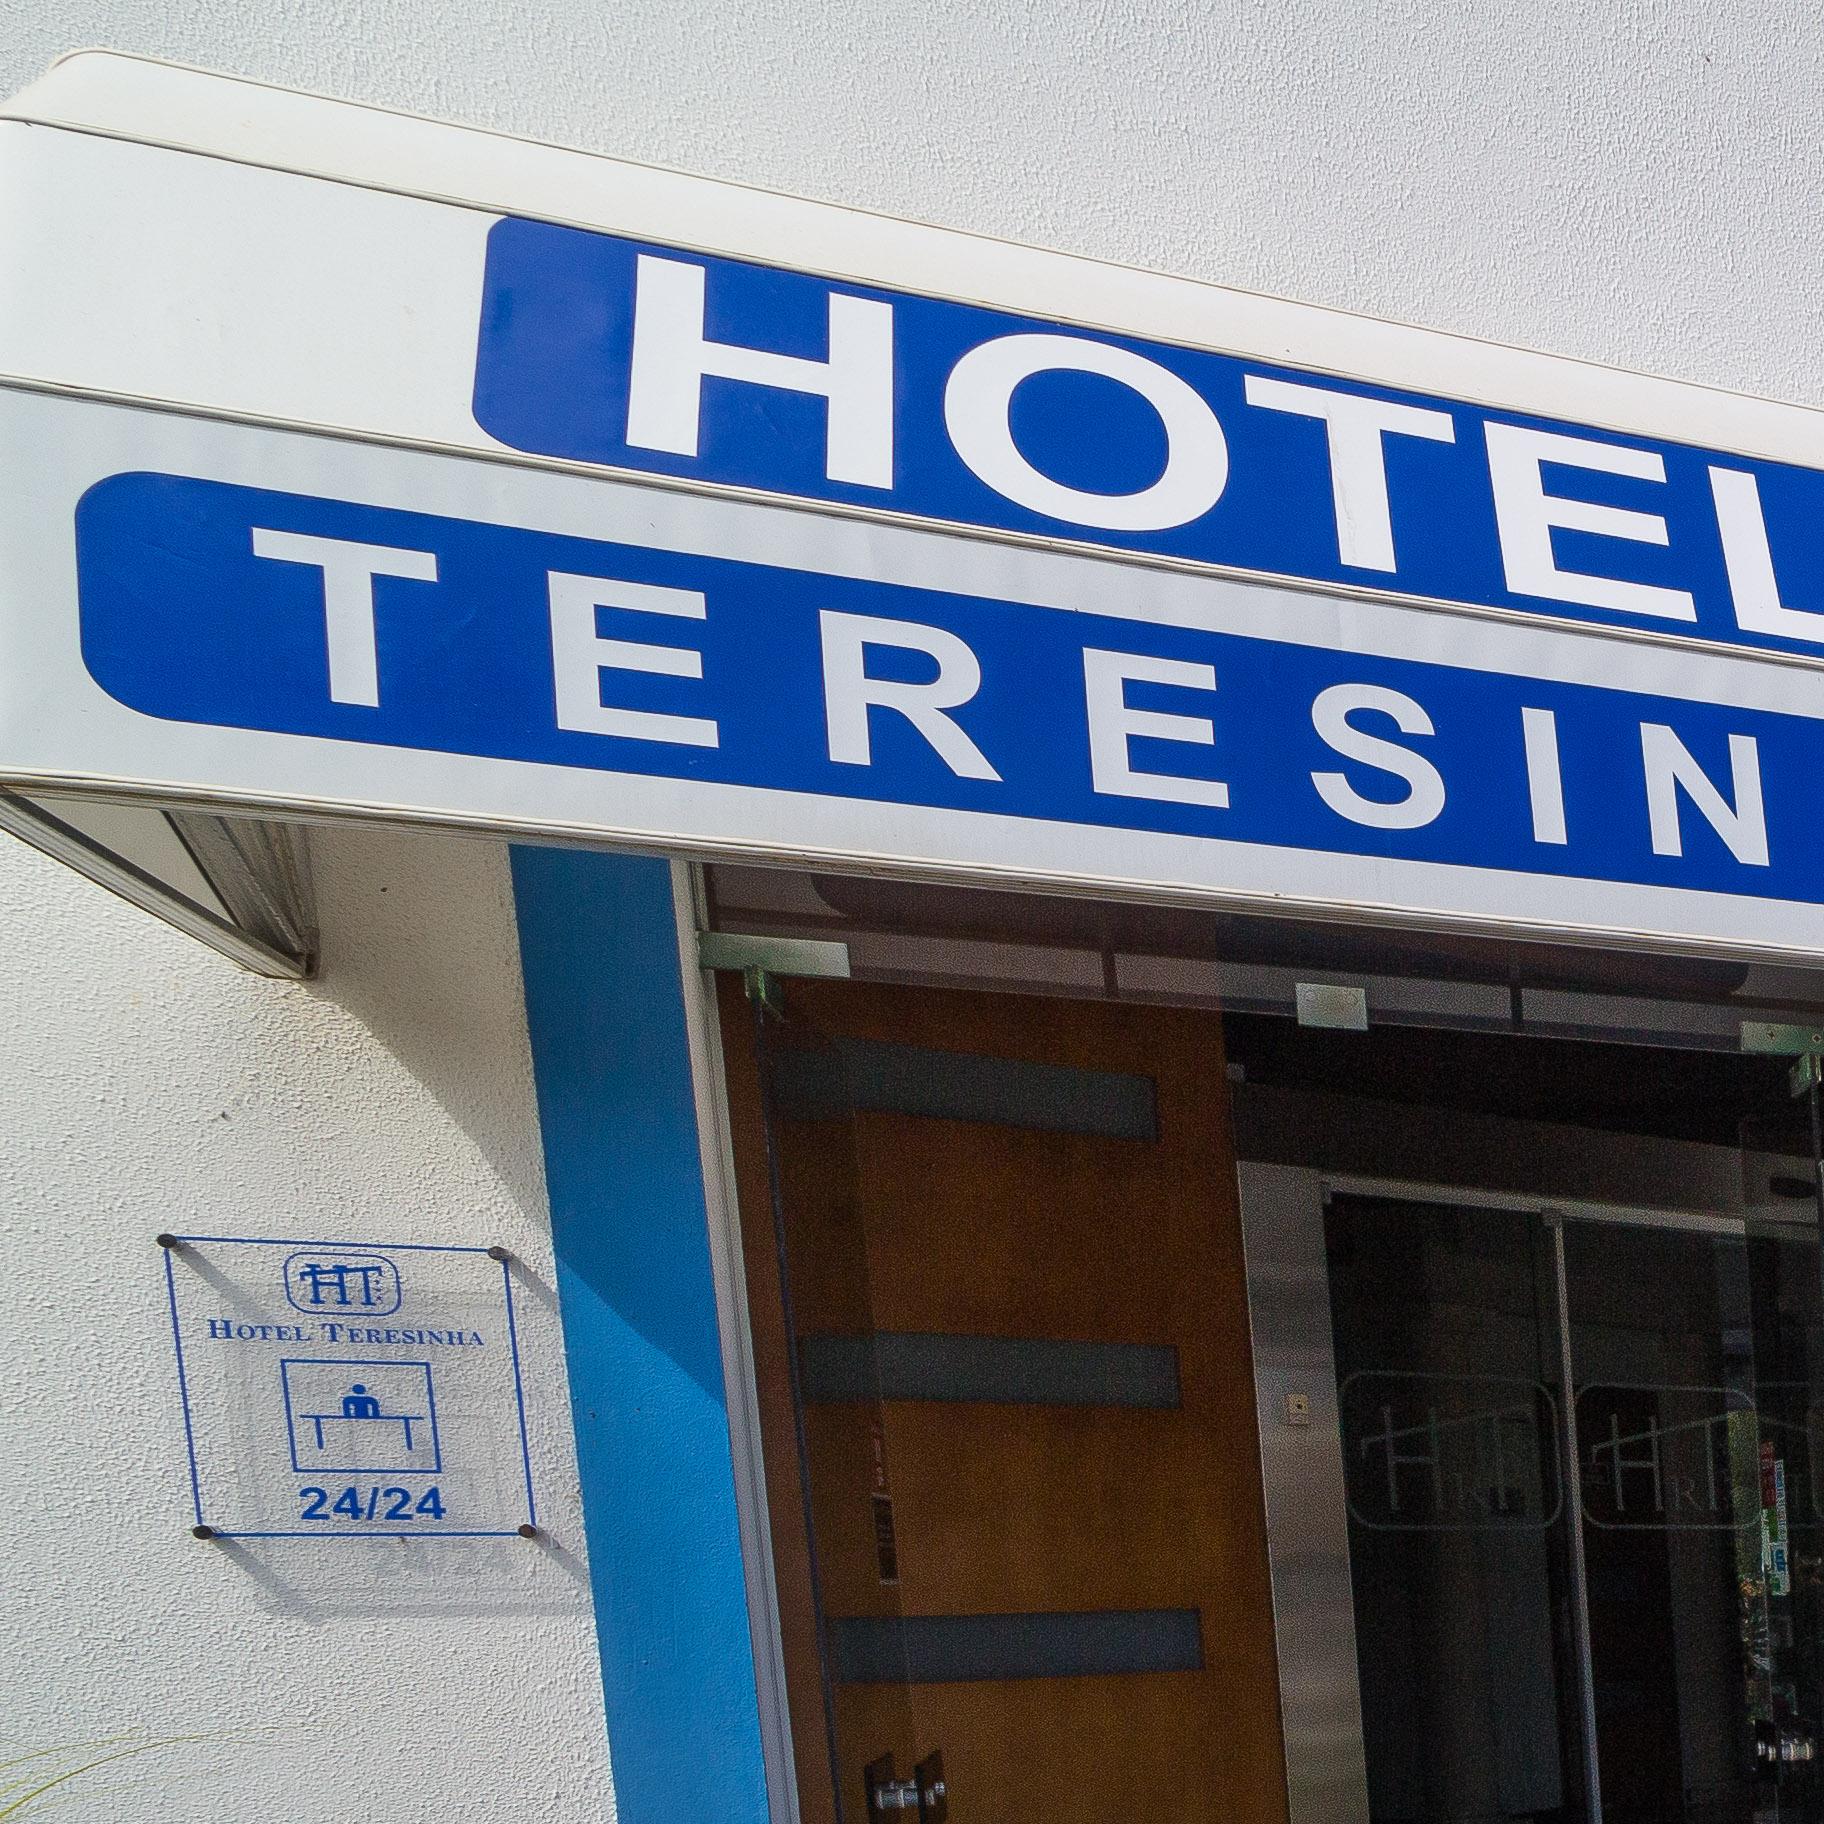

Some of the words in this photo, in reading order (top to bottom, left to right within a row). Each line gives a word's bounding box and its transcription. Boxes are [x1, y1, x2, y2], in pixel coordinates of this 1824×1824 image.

[207, 1318, 311, 1342] HOTEL
[320, 1322, 485, 1346] TERESINHA
[297, 1484, 449, 1522] 24/24
